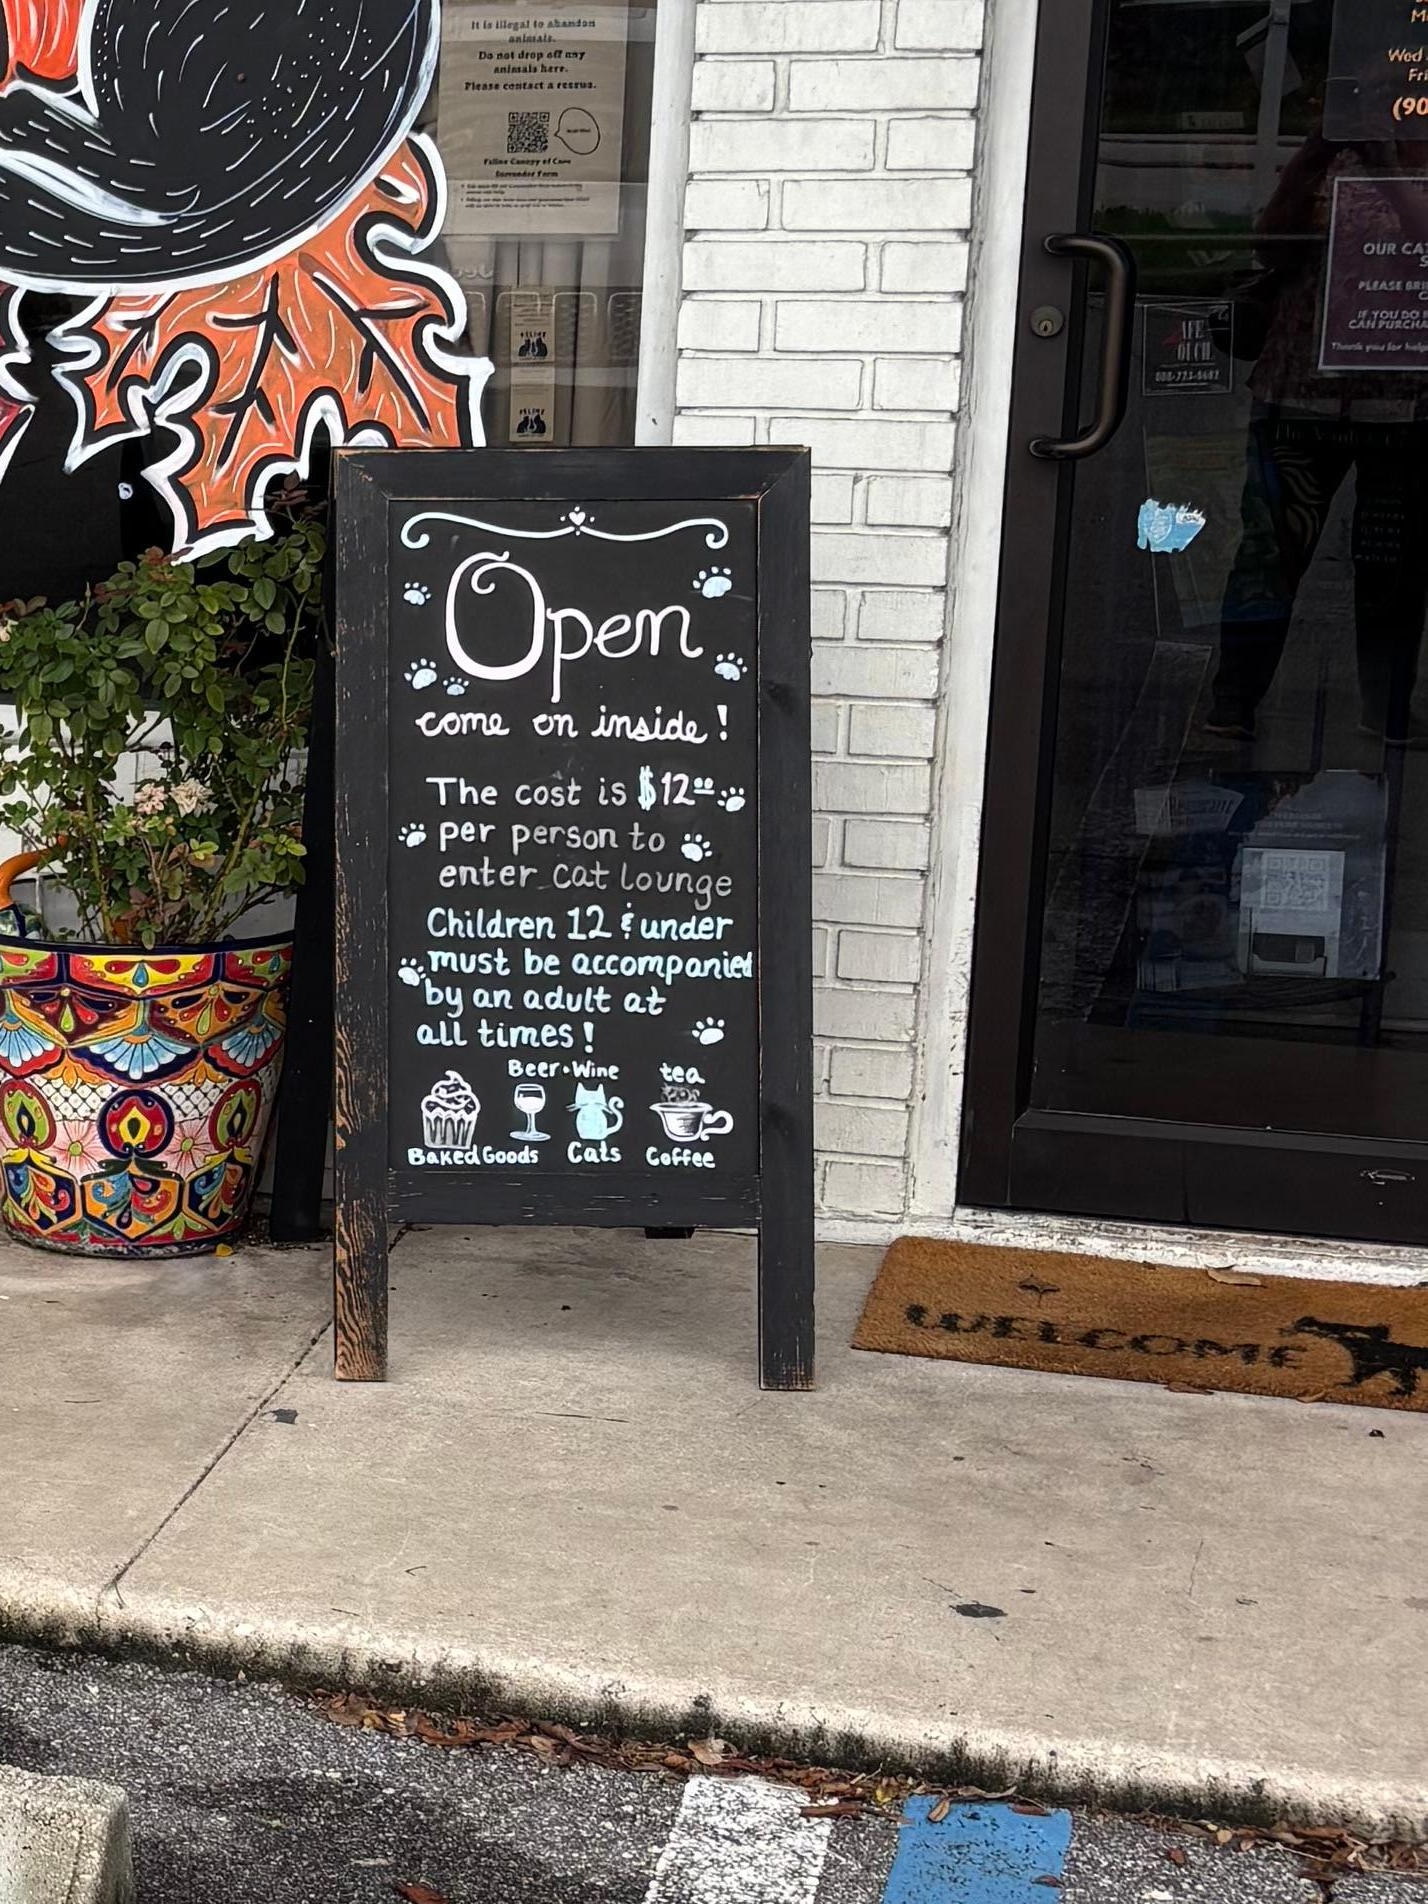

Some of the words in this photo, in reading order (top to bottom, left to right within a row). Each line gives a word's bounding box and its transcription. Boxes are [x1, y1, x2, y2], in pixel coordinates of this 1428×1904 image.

[495, 19, 530, 32] illegal
[534, 20, 544, 29] to
[547, 18, 596, 28] abandon
[478, 50, 494, 61] Do
[497, 50, 515, 60] not
[518, 49, 544, 61] drop
[546, 49, 564, 59] off
[565, 50, 586, 61] any
[1388, 47, 1423, 63] Wed
[493, 64, 538, 74] animals
[503, 81, 544, 91] contact
[1363, 242, 1397, 256] OUR
[1358, 279, 1403, 292] PLEASE
[1372, 309, 1399, 321] YOU
[445, 550, 704, 704] Open
[415, 711, 510, 737] come
[532, 713, 578, 738] on
[425, 777, 498, 807] The
[514, 776, 582, 808] cost
[598, 777, 627, 807] is
[439, 820, 497, 852] per
[511, 822, 619, 856] person
[628, 822, 666, 852] to
[439, 855, 538, 889] enter
[427, 906, 556, 940] Children
[567, 904, 613, 941] 12
[640, 915, 734, 942] under
[427, 947, 511, 976] must
[524, 947, 561, 976] be
[571, 950, 753, 986] accompanied
[424, 977, 464, 1018] by
[472, 985, 514, 1010] an
[523, 985, 612, 1014] adult
[623, 985, 667, 1016] at
[416, 1019, 468, 1047] all
[658, 1062, 706, 1085] tea
[407, 1143, 481, 1166] Baked
[482, 1145, 539, 1165] Goods
[567, 1141, 623, 1164] Cats
[645, 1148, 716, 1169] Coffee
